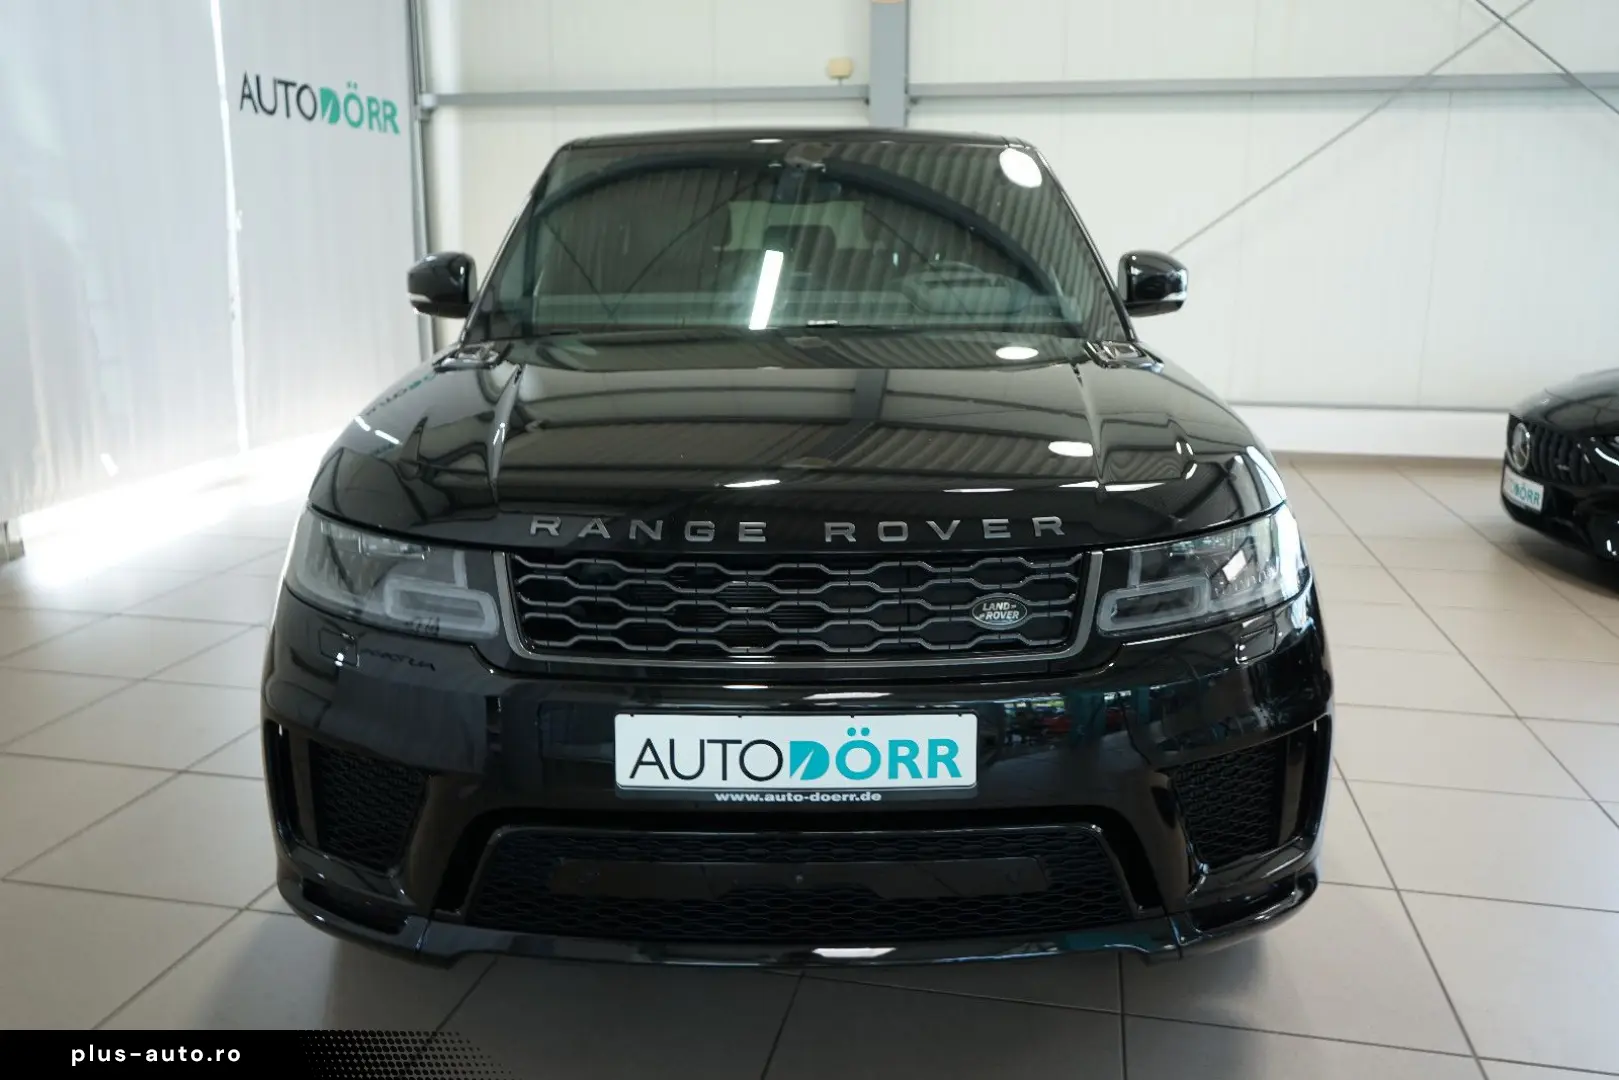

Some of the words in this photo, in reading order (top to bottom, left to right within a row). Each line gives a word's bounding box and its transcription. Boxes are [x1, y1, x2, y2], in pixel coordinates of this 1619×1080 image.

[239, 70, 400, 135] AUTODÖRR
[529, 515, 767, 543] RANGE
[824, 516, 1065, 543] ROVER
[982, 601, 1011, 611] LAND
[985, 611, 1020, 620] ROVER
[629, 727, 962, 782] AUTODÖRR
[714, 791, 882, 803] www.auto-doerr.de
